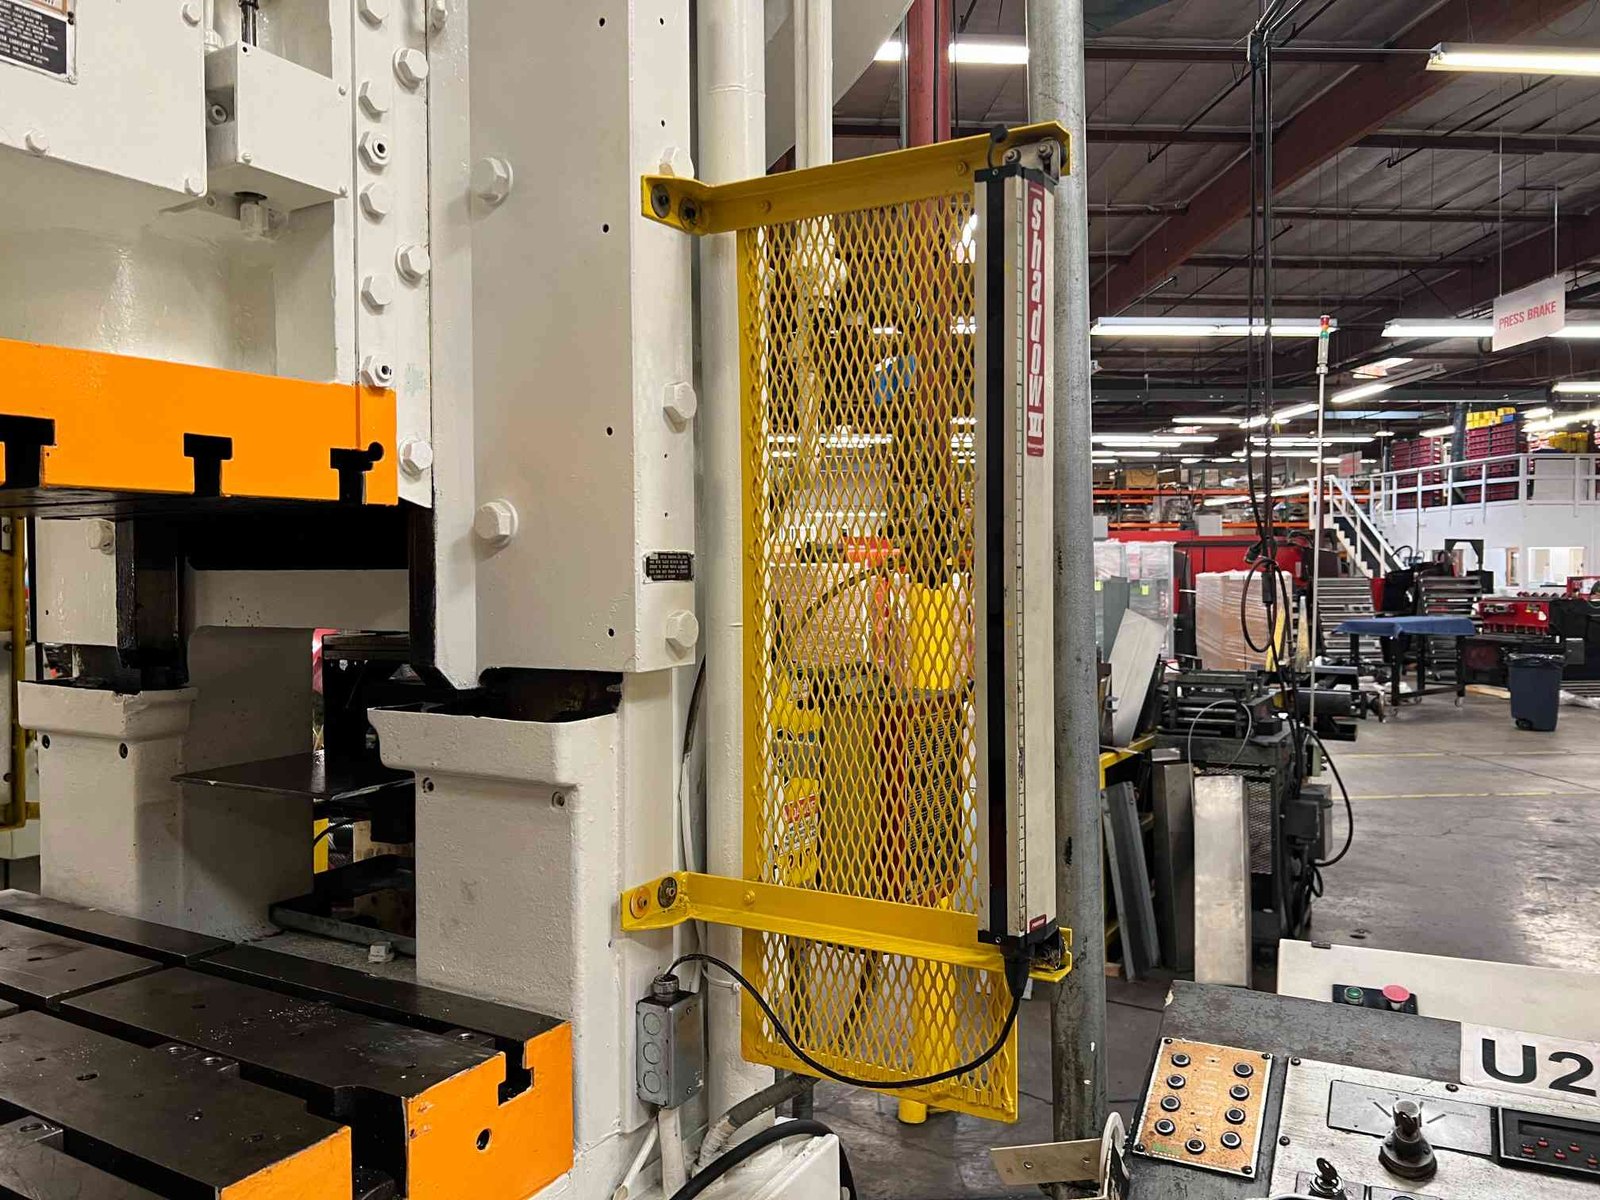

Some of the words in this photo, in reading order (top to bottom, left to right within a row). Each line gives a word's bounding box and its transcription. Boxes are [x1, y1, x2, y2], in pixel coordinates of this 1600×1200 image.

[1499, 311, 1525, 329] PRESS
[1527, 300, 1557, 320] BRAKE
[1482, 1038, 1597, 1097] U2
